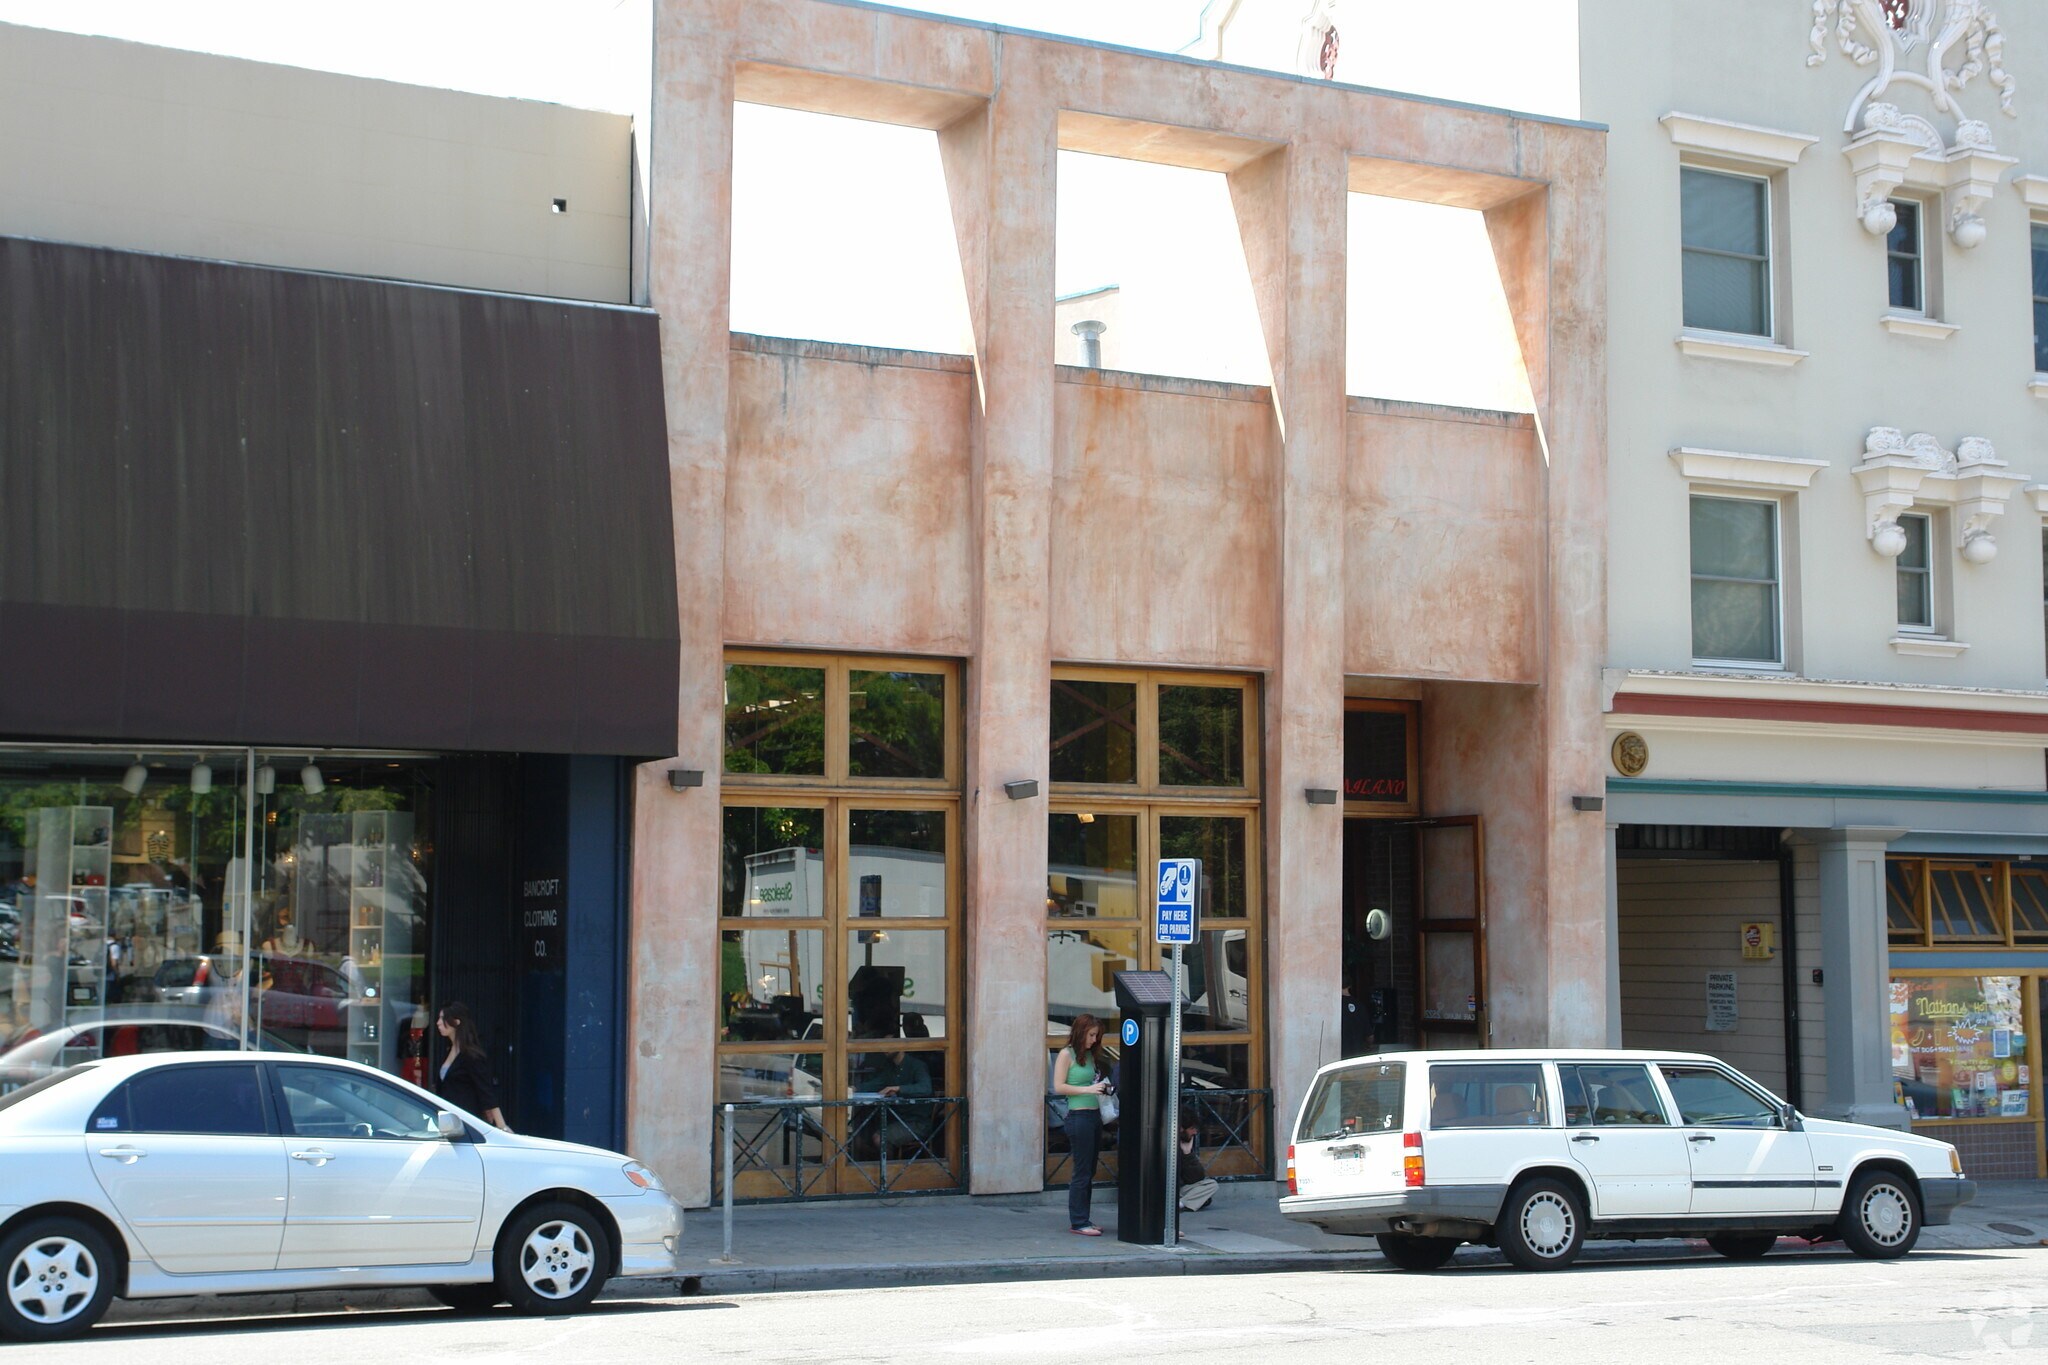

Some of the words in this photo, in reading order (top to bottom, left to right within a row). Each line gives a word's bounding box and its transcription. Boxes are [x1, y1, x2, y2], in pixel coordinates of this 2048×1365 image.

[1181, 866, 1188, 879] 1
[524, 879, 559, 896] BANCROFT
[524, 909, 557, 927] CLOTHING
[1162, 911, 1173, 921] PAY
[1173, 911, 1188, 921] HERE
[1159, 923, 1169, 935] FOR
[1169, 923, 1191, 935] PARKING
[534, 940, 547, 957] CO.
[1709, 974, 1733, 982] PRIVATE
[1126, 1023, 1135, 1042] P
